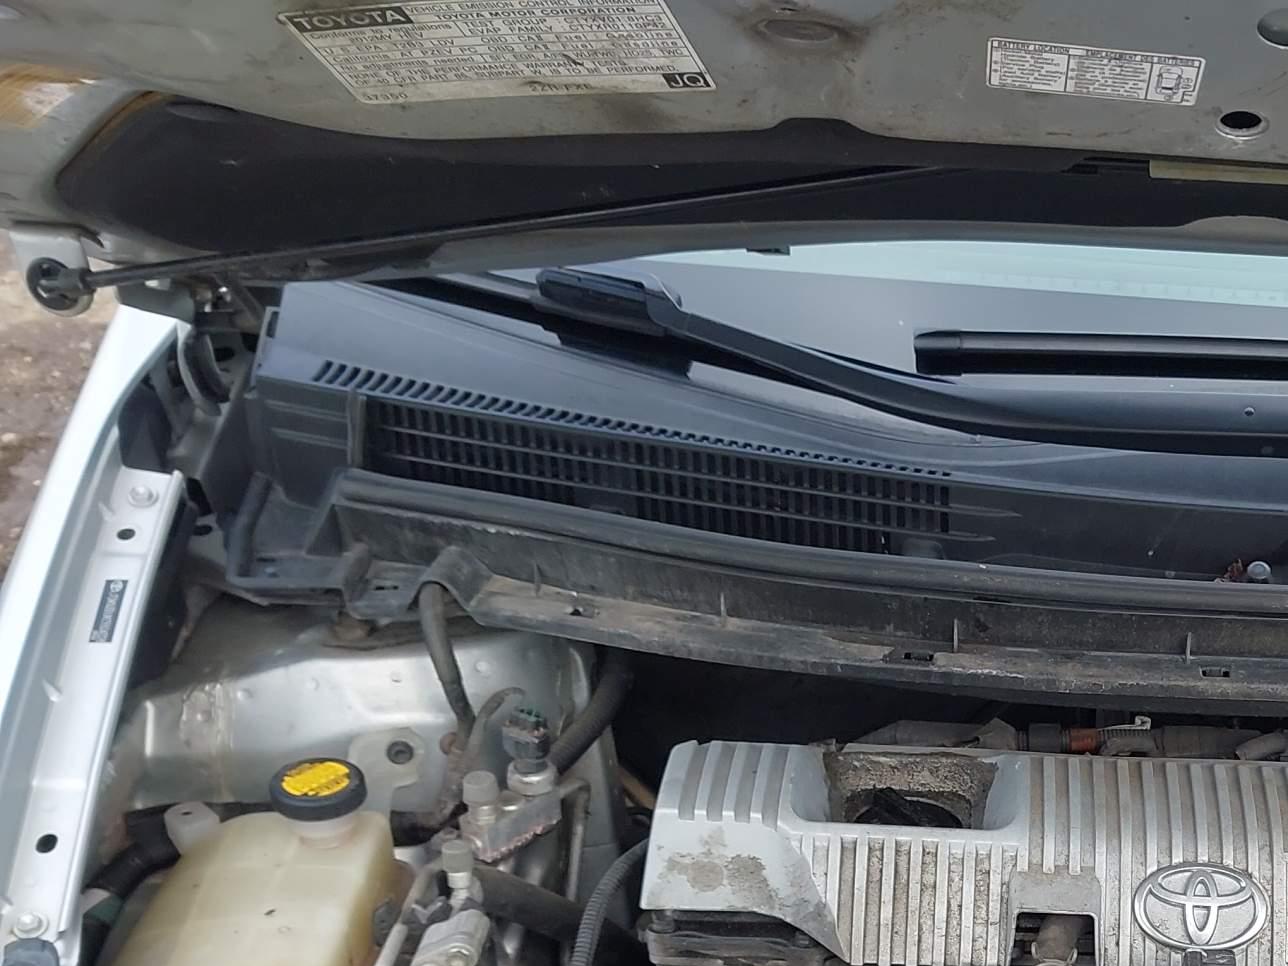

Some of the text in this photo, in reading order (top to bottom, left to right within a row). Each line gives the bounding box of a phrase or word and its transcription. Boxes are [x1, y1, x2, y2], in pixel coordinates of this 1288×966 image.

[406, 4, 455, 14] VEHICLE
[460, 1, 514, 11] EMISSION
[519, 0, 575, 8] CONTROL
[436, 6, 636, 21] TOYOTA MOTOR CORPORATION
[293, 9, 406, 30] TOYOTA
[462, 20, 494, 29] TEST
[501, 18, 548, 27] GROUP
[311, 23, 452, 40] Conforms to regulations
[350, 31, 424, 43] 2012MY HEV
[469, 25, 500, 35] EVAP
[509, 24, 554, 33] FAMILY
[430, 38, 455, 47] LDV
[554, 32, 589, 41] Fuel
[606, 31, 673, 39] Gasoline
[333, 53, 389, 64] California
[461, 46, 479, 54] PC
[561, 41, 594, 49] Fuel
[612, 40, 678, 48] Gasoline
[999, 41, 1030, 50] BATTERY
[1034, 44, 1070, 54] LOCATION
[363, 58, 429, 71] adjustments
[433, 56, 475, 65] needed
[662, 48, 683, 56] TWC
[349, 72, 379, 81] NONE
[385, 69, 401, 77] OF
[408, 67, 427, 75] THE
[433, 63, 517, 74] PERFORMANCE
[523, 59, 584, 69] WARRANTY
[394, 75, 416, 83] CFR
[422, 73, 450, 82] PART
[474, 68, 526, 79] SUBPART
[566, 67, 582, 75] TO
[670, 73, 706, 88] JQ
